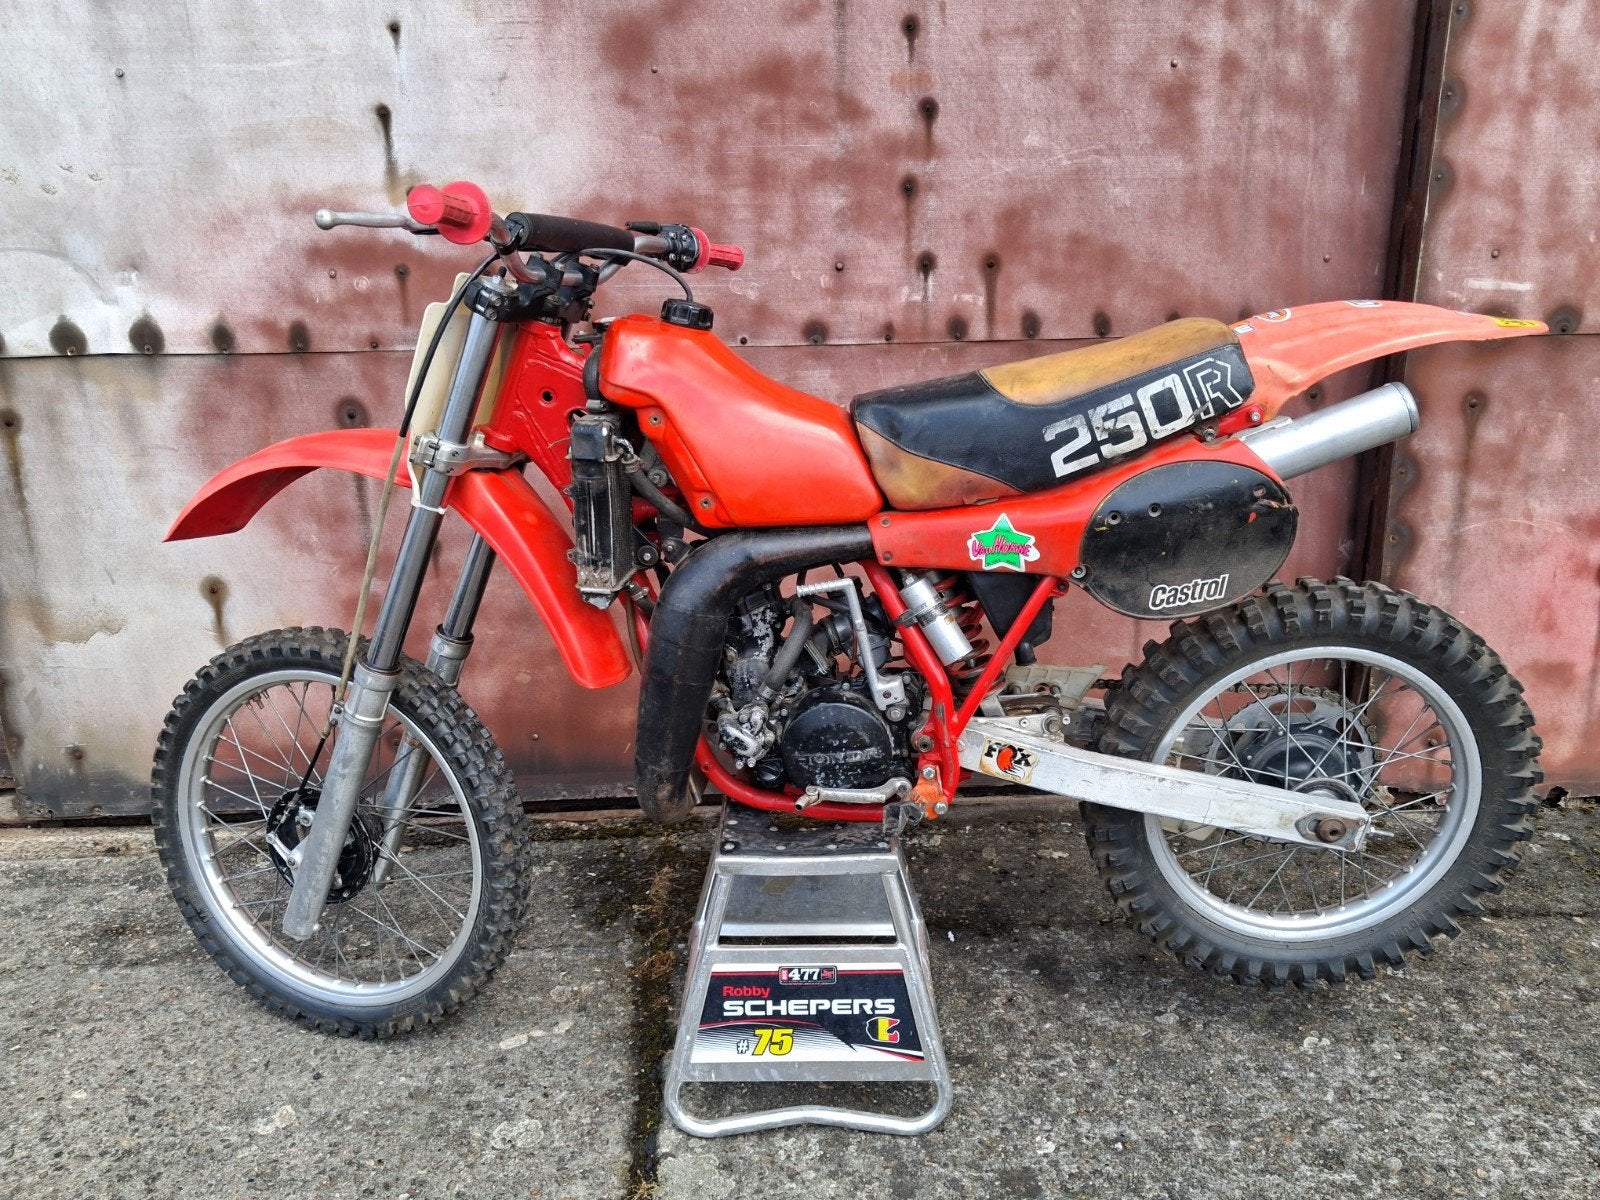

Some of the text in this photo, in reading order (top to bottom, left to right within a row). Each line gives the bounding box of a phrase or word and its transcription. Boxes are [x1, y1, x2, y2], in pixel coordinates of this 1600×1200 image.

[1042, 358, 1244, 478] 250R
[1149, 573, 1230, 610] Castrol
[984, 741, 1032, 770] FOX
[788, 968, 820, 981] 477
[722, 985, 771, 998] Robby
[722, 998, 896, 1017] SCHEPERS
